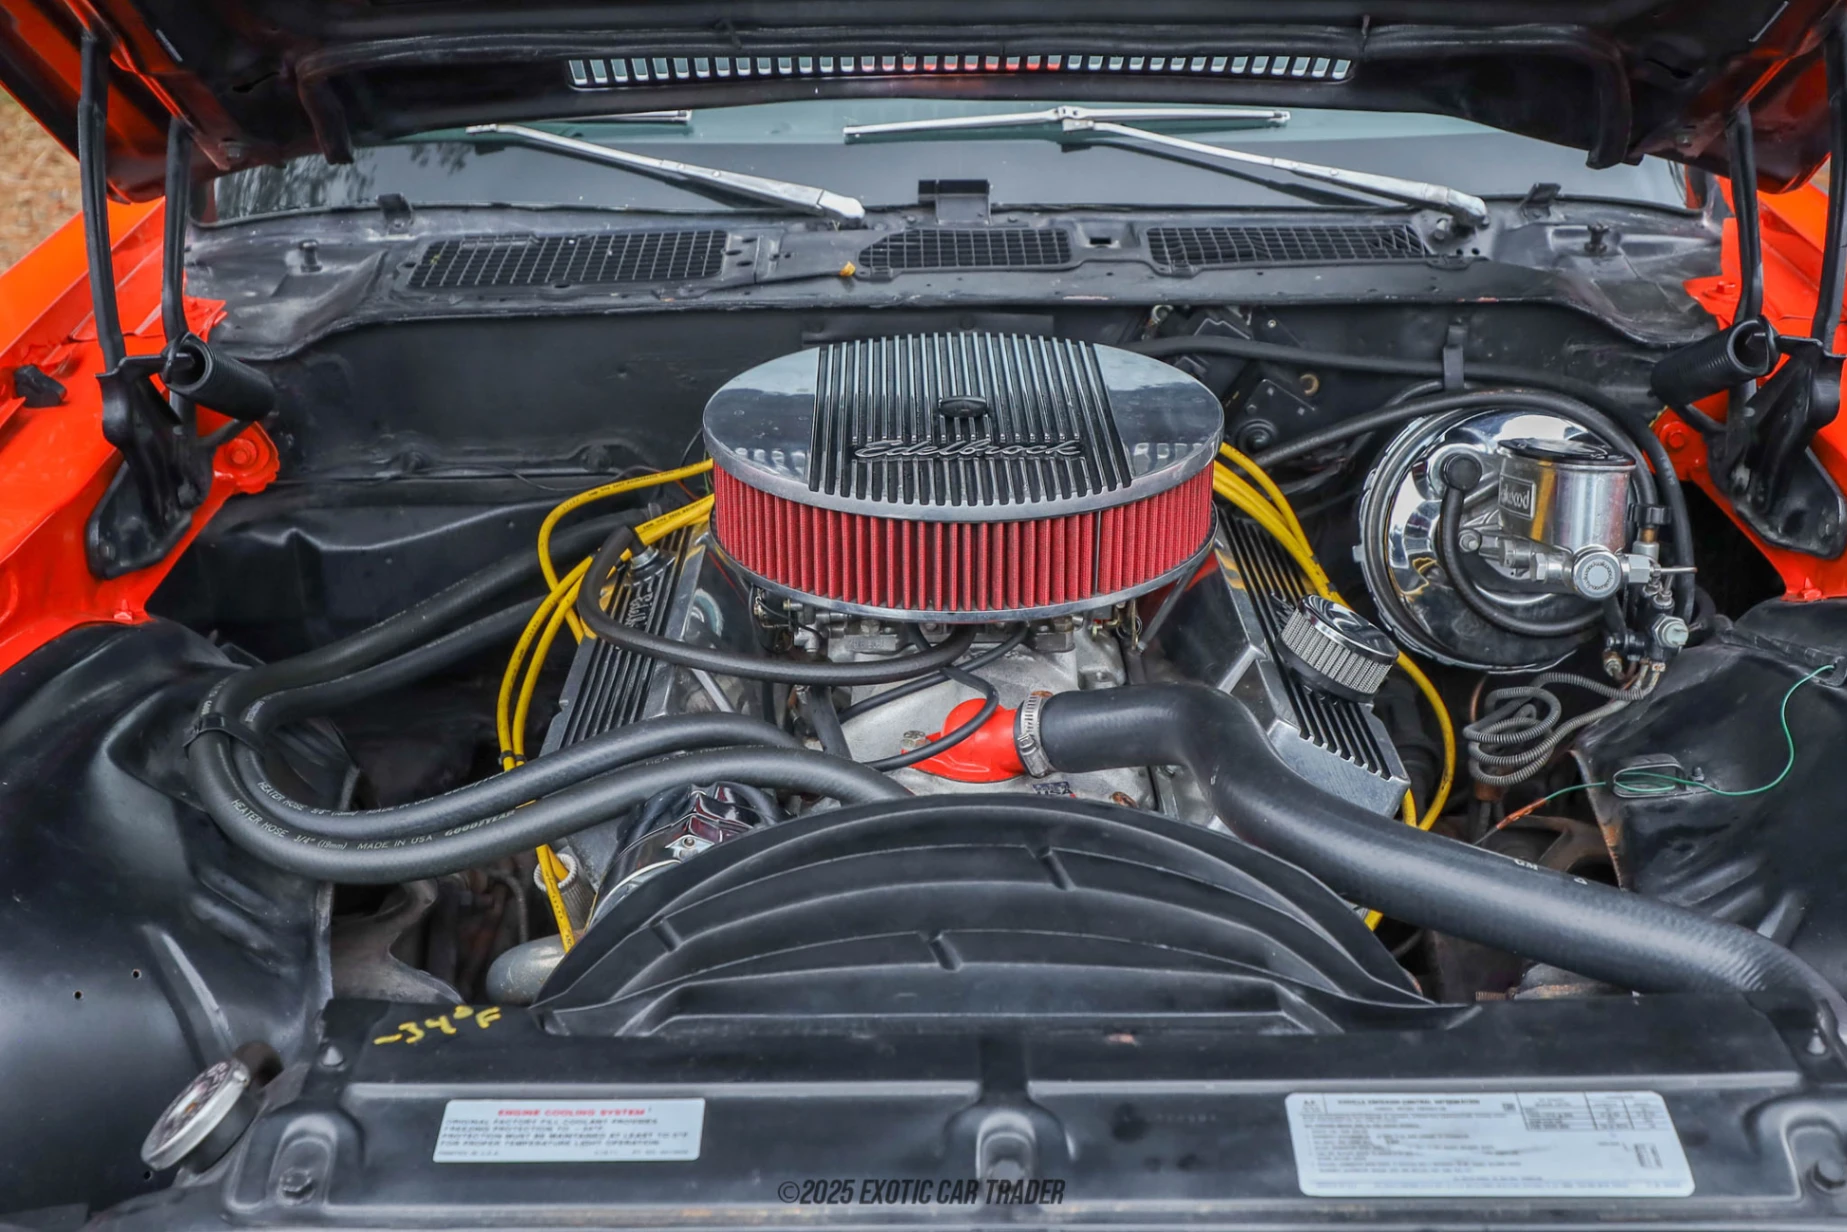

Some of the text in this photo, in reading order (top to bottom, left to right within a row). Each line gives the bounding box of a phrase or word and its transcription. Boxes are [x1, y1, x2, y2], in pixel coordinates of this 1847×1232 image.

[854, 438, 1081, 457] Edelbrock
[257, 781, 286, 801] HEATER
[231, 799, 262, 824] HEATER
[261, 821, 289, 838] HOSE
[317, 840, 348, 850] (19mm)
[357, 842, 389, 850] MADE
[394, 839, 405, 847] IN
[411, 834, 433, 845] USA
[444, 809, 516, 837] GOODYEAR
[1514, 859, 1538, 871] GM
[498, 1108, 646, 1117] ENGINE COOLING SYSTEM
